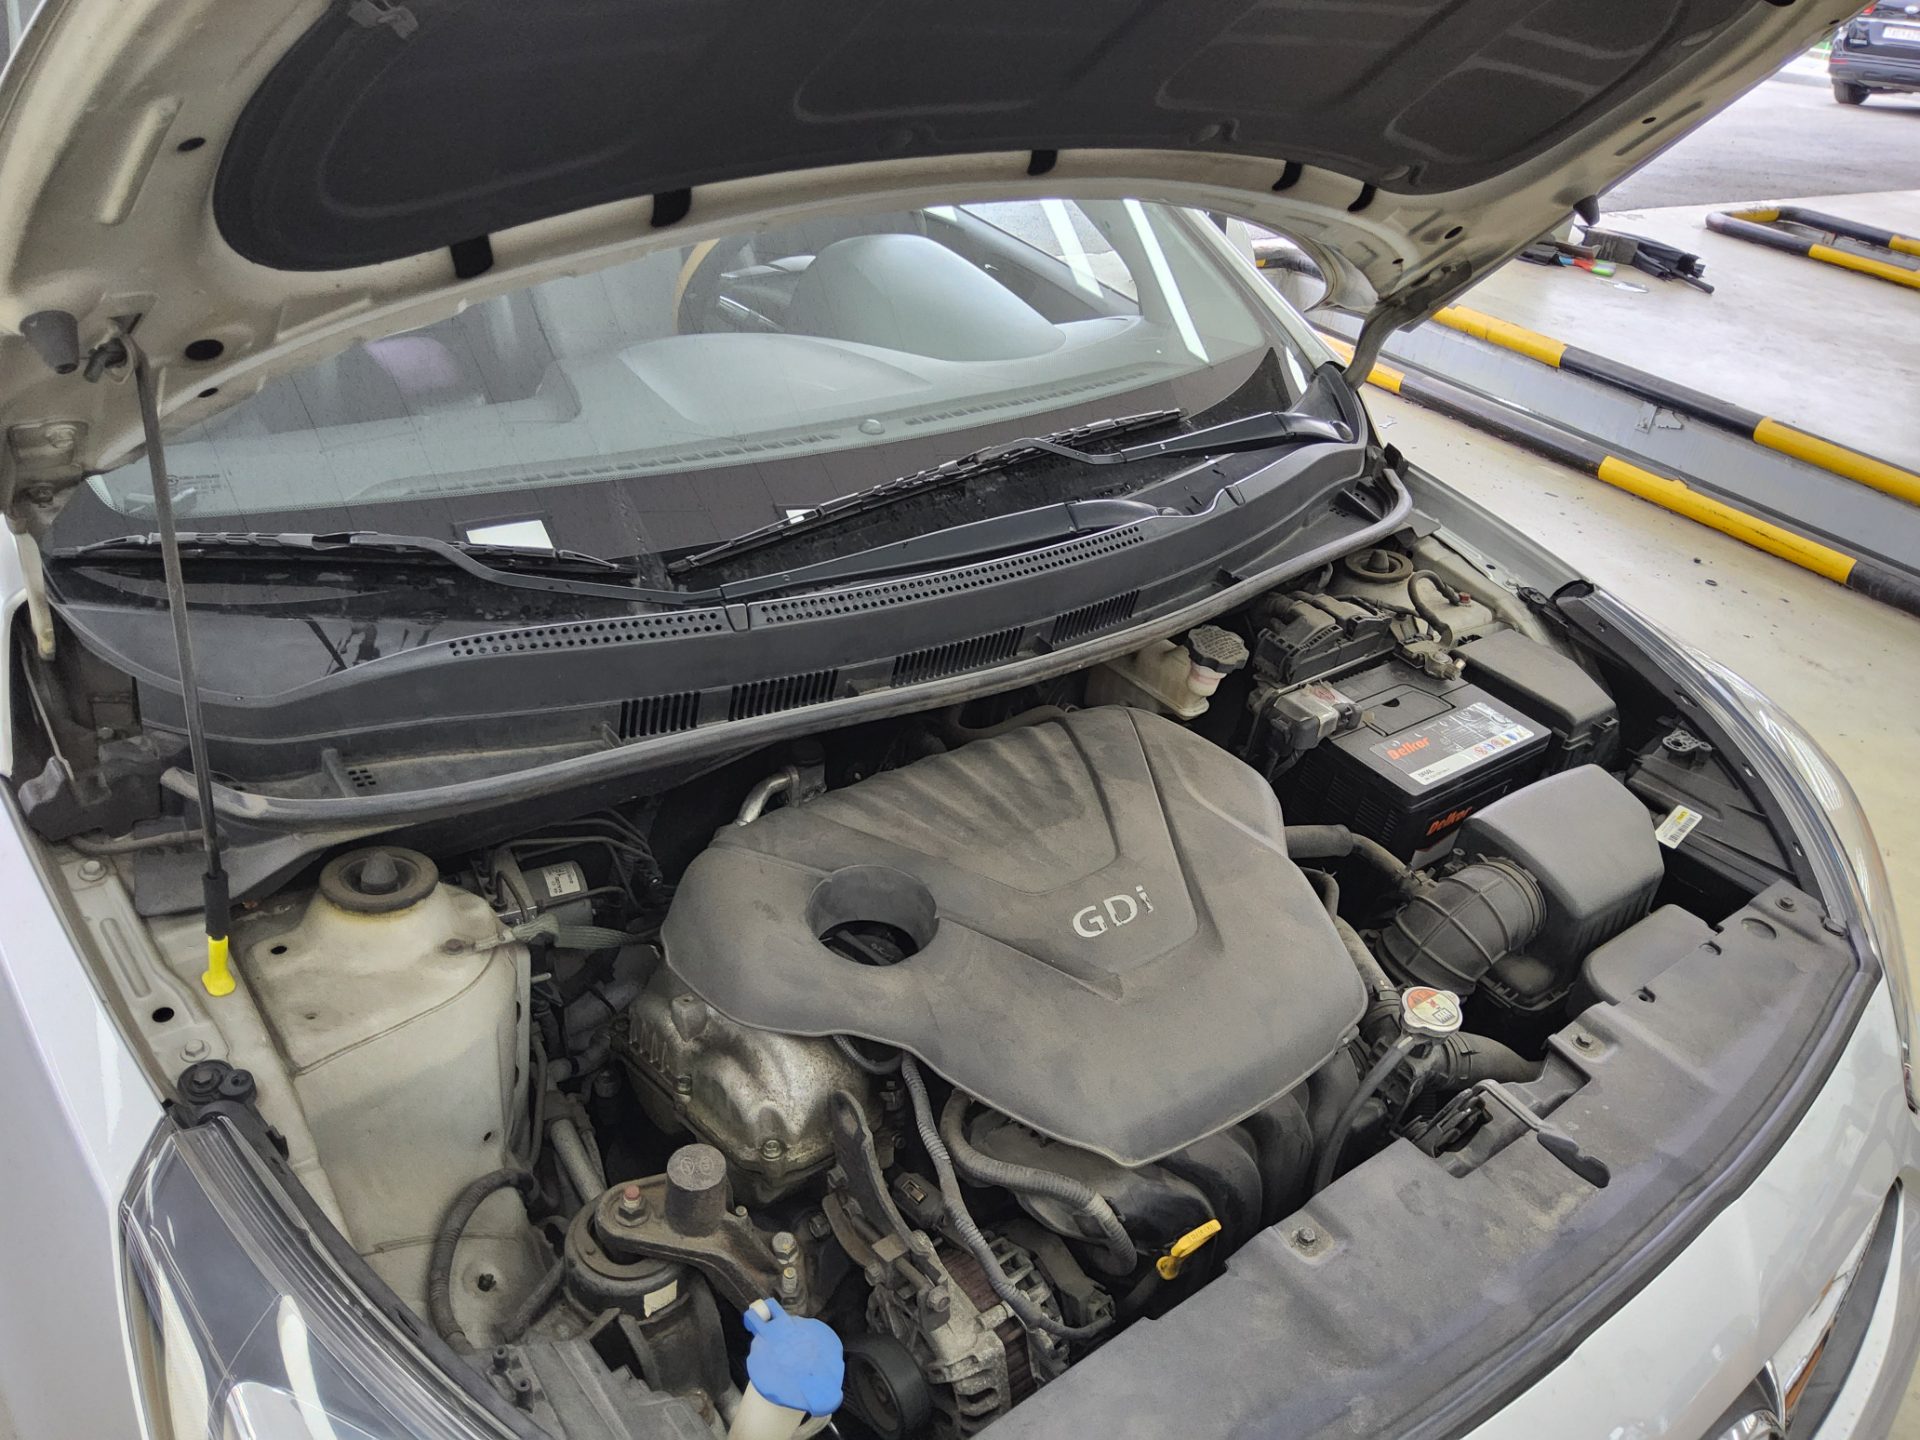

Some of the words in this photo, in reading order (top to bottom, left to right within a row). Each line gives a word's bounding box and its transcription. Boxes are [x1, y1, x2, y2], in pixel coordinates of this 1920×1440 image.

[1387, 737, 1430, 760] Delkor
[1426, 806, 1473, 836] Delkor
[1072, 885, 1154, 938] GDi
